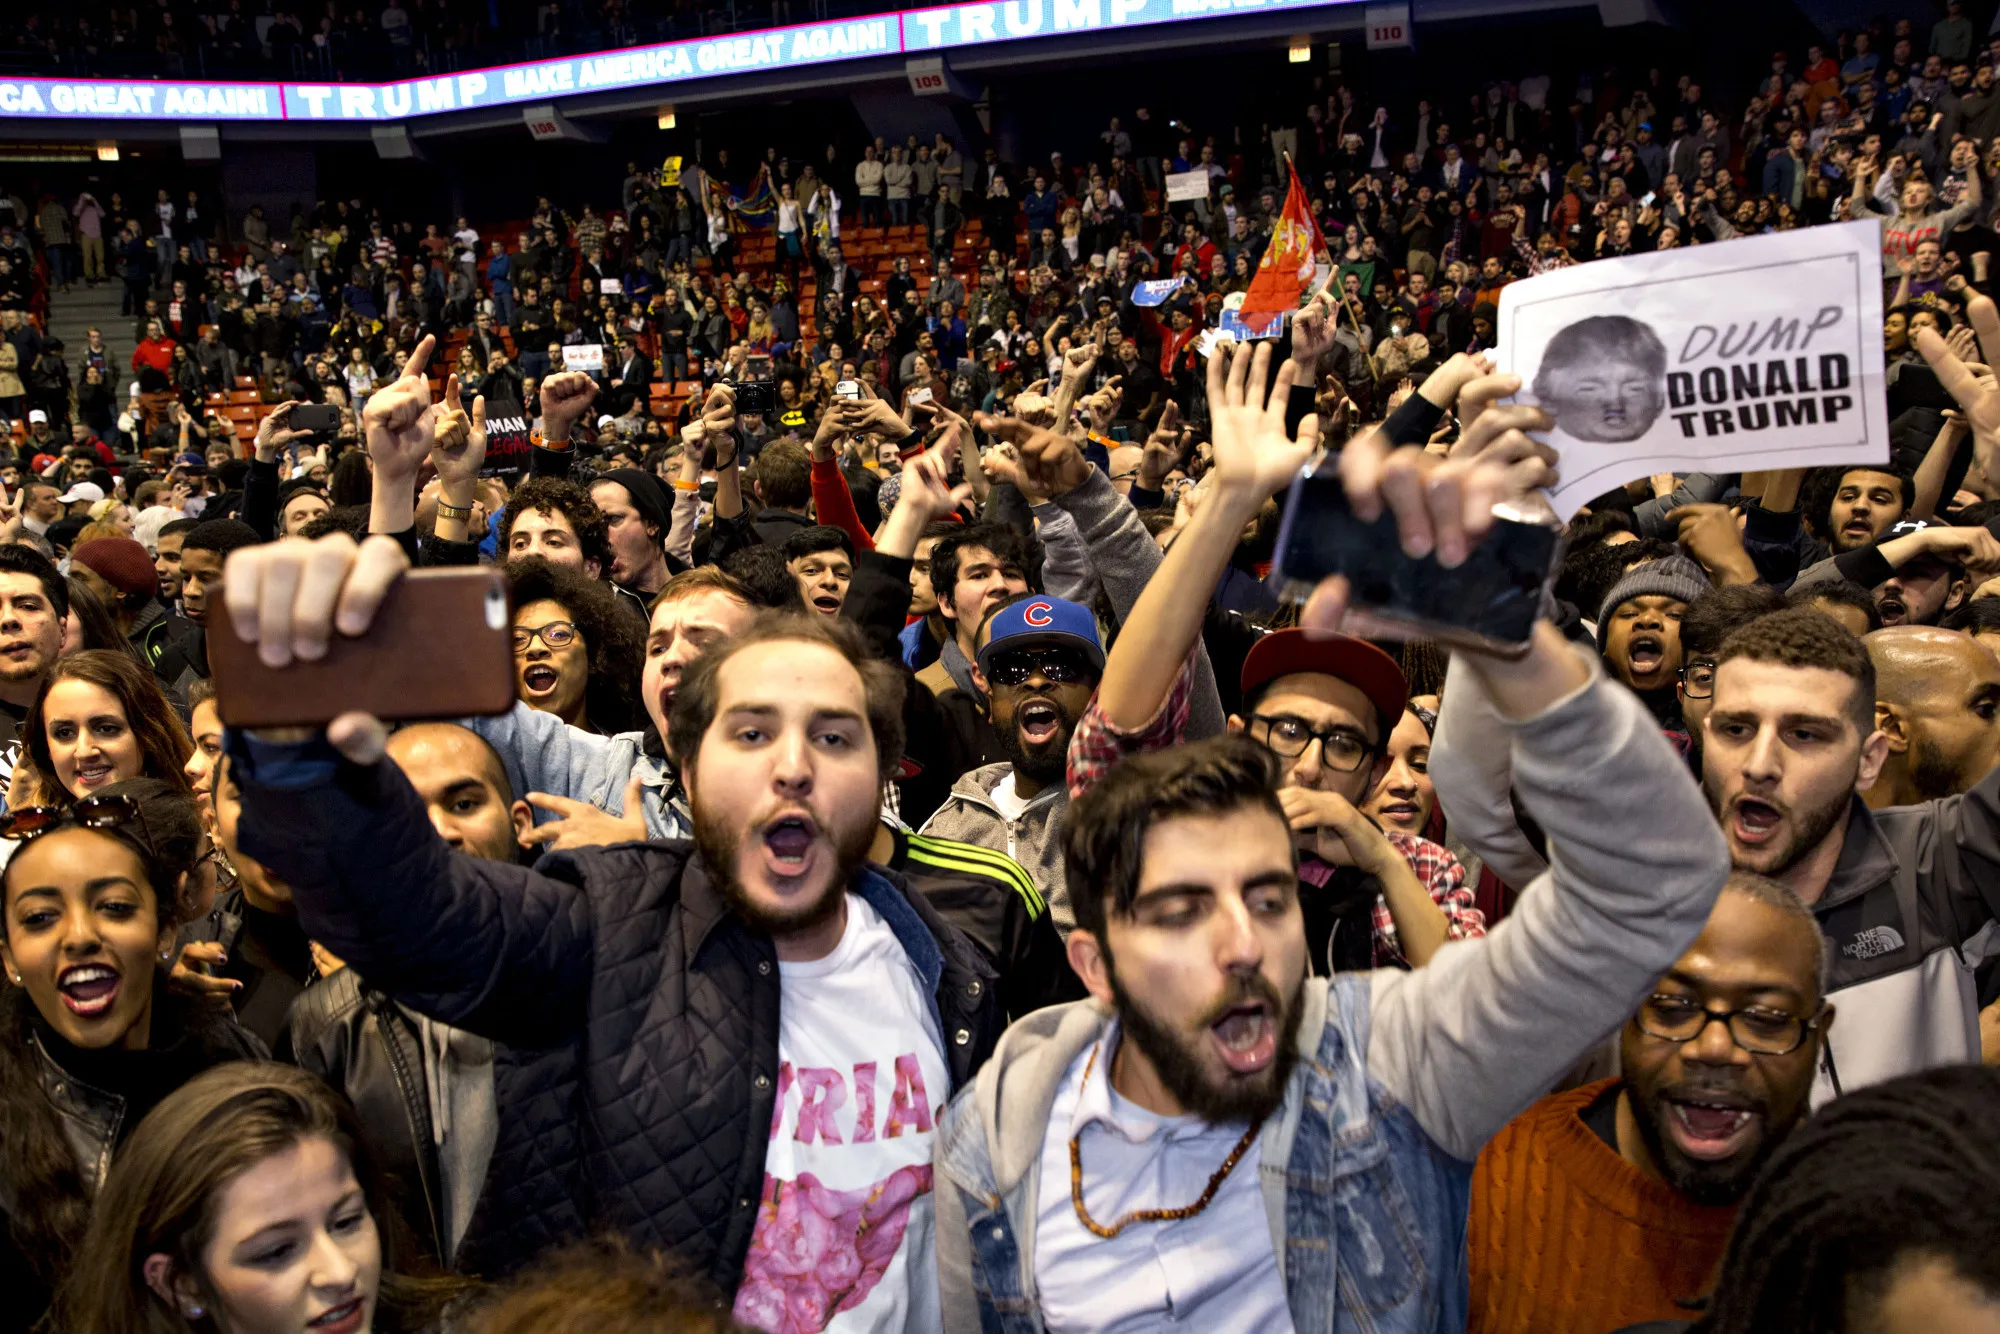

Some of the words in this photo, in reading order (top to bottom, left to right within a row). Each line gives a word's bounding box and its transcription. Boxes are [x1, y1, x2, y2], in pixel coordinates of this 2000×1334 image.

[917, 0, 1147, 45] TRUMP
[1374, 26, 1402, 41] 110
[297, 73, 487, 118] TRUMP
[503, 63, 573, 98] MAKE
[578, 47, 692, 88] AMERICA
[697, 34, 785, 70] GREAT
[790, 20, 886, 61] AGAIN!
[915, 75, 942, 89] 109
[50, 85, 155, 113] GREAT
[164, 87, 268, 114] AGAIN!
[532, 122, 556, 134] 108
[1678, 305, 1844, 364] DUMP
[1666, 353, 1851, 410] DONALD
[485, 416, 527, 435] UMAN
[1670, 394, 1853, 438] TRUMP
[1023, 601, 1053, 627] C
[1854, 928, 1878, 942] THE
[1842, 938, 1882, 956] NORTH
[1856, 946, 1885, 960] FACE
